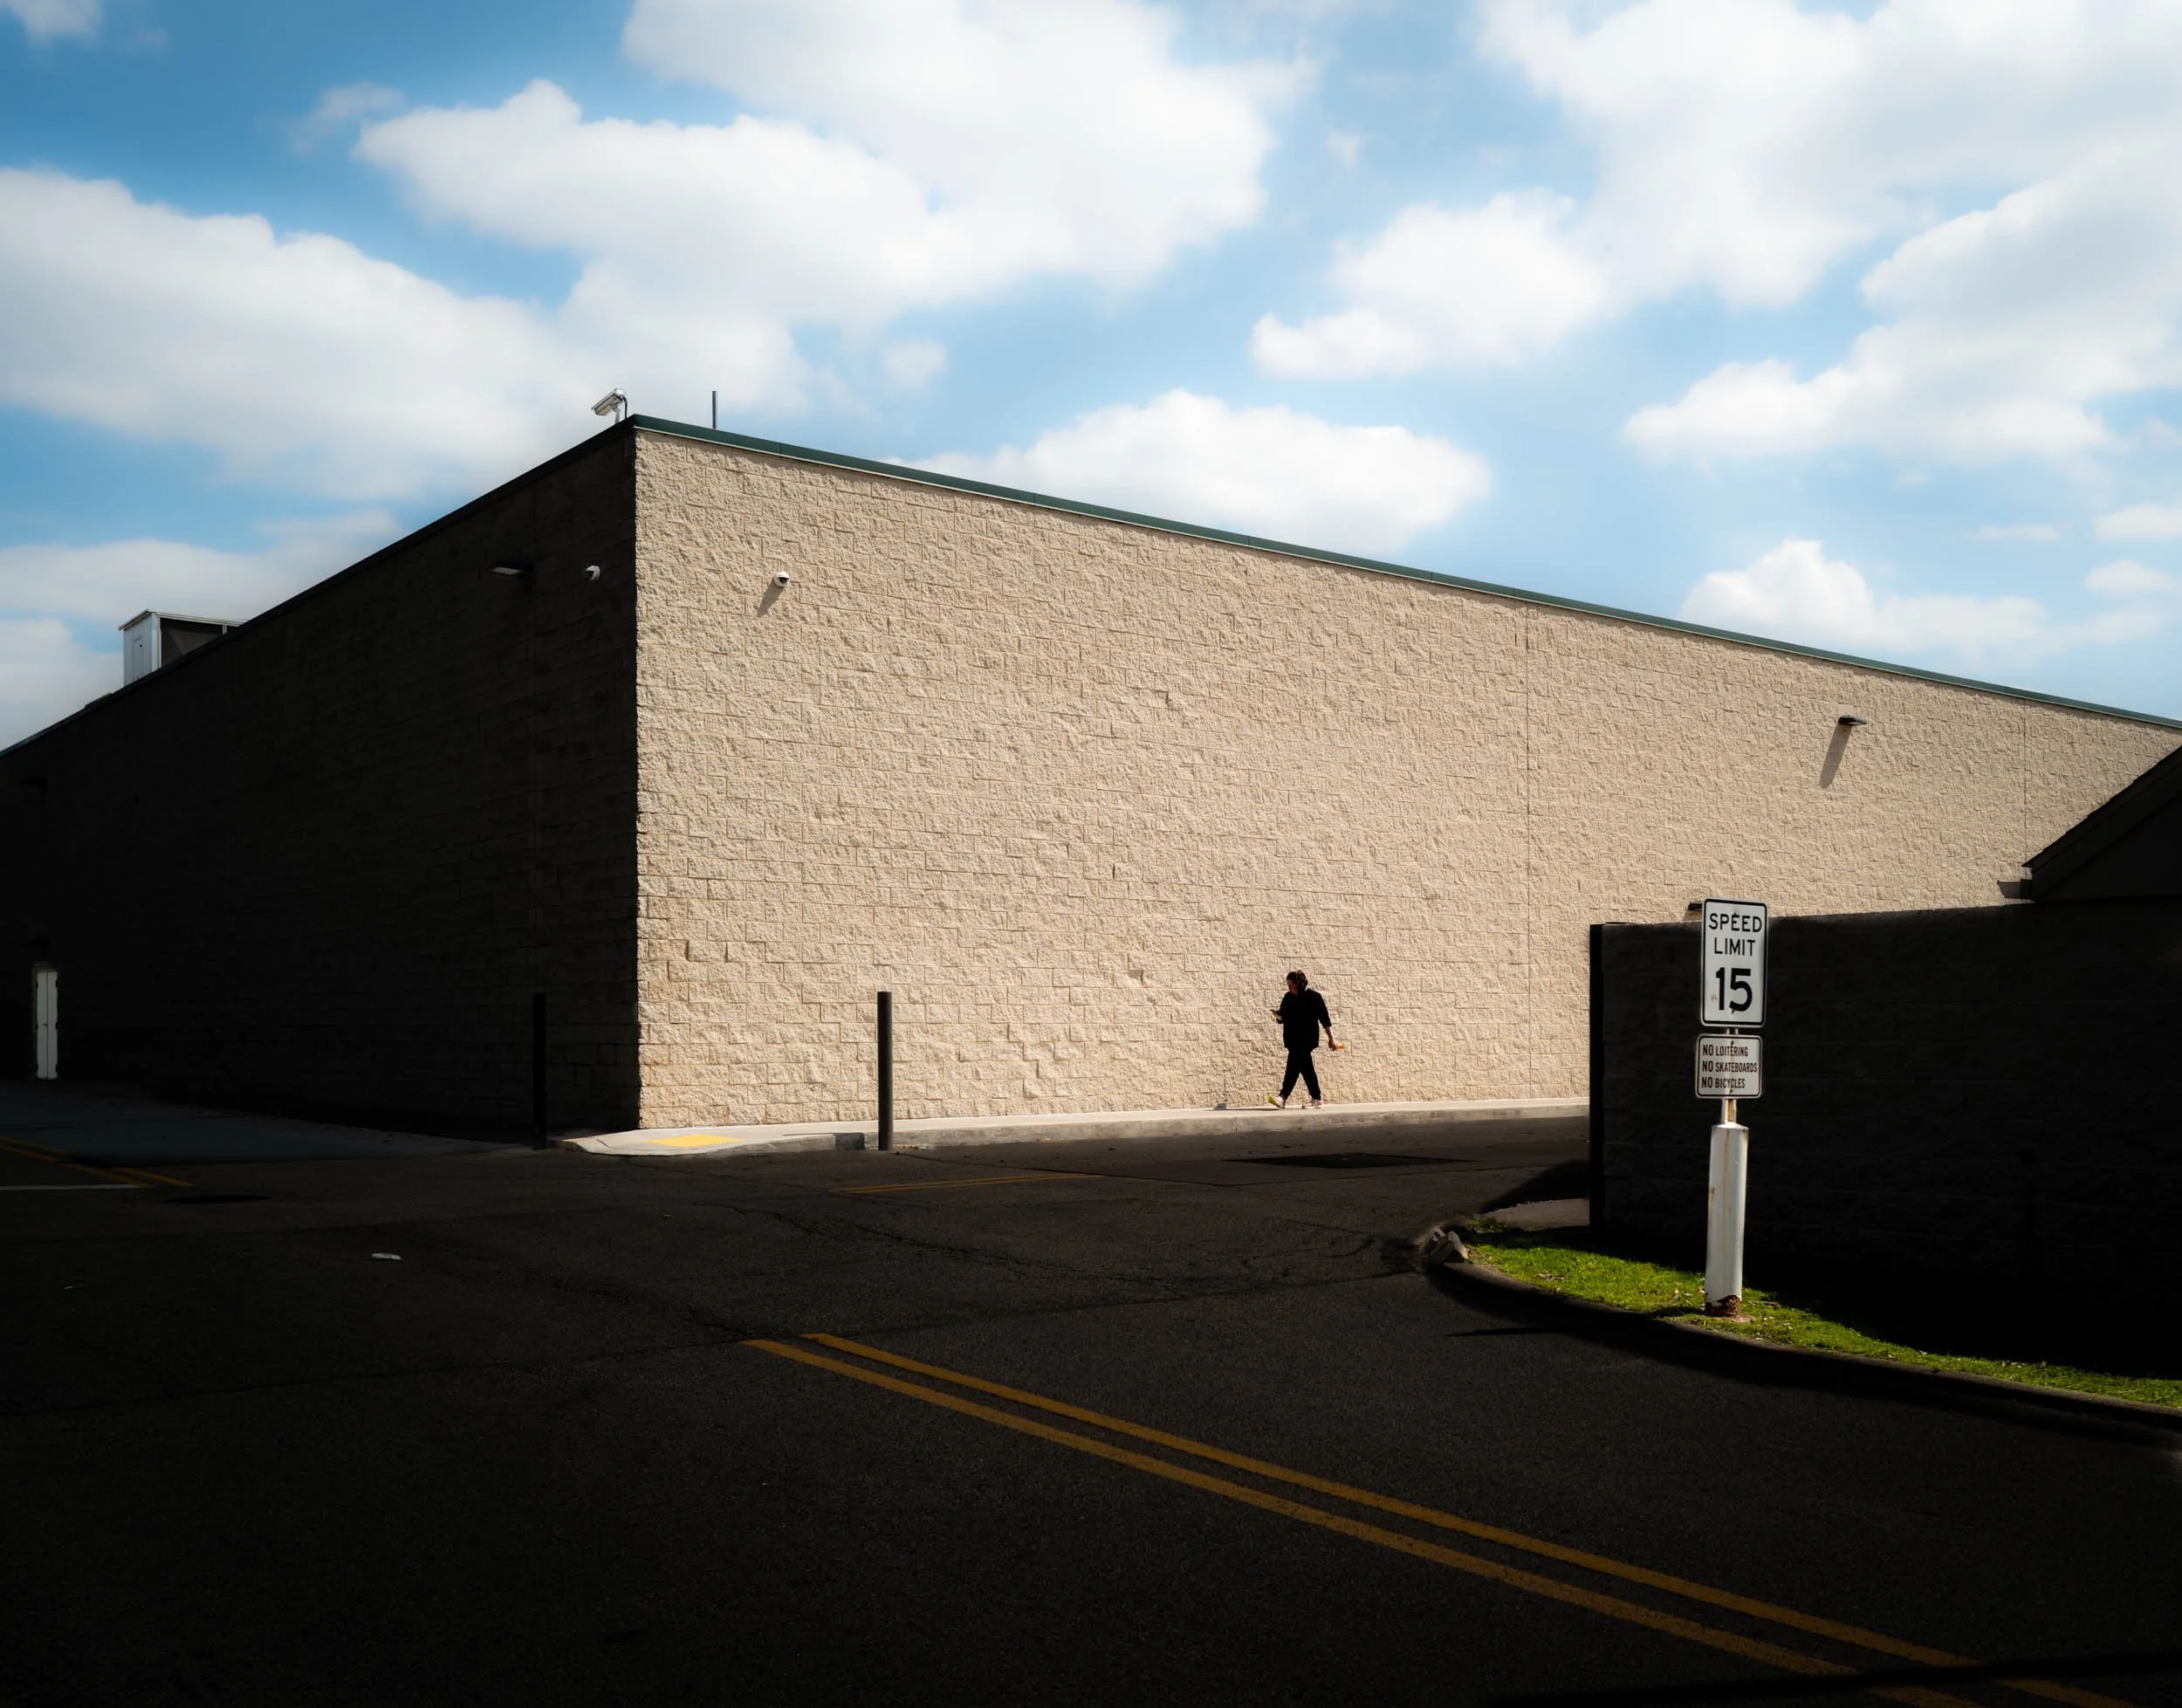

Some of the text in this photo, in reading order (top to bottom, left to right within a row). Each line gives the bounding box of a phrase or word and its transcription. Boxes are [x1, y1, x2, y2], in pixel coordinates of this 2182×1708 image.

[1708, 913, 1762, 933] SPEED
[1714, 936, 1756, 957] LIMIT
[1716, 967, 1753, 1012] 15
[1703, 1045, 1748, 1056] NO LOITERING
[1702, 1060, 1758, 1073] NO SKATEBOARDS
[1701, 1076, 1746, 1088] NO BICYCLES
